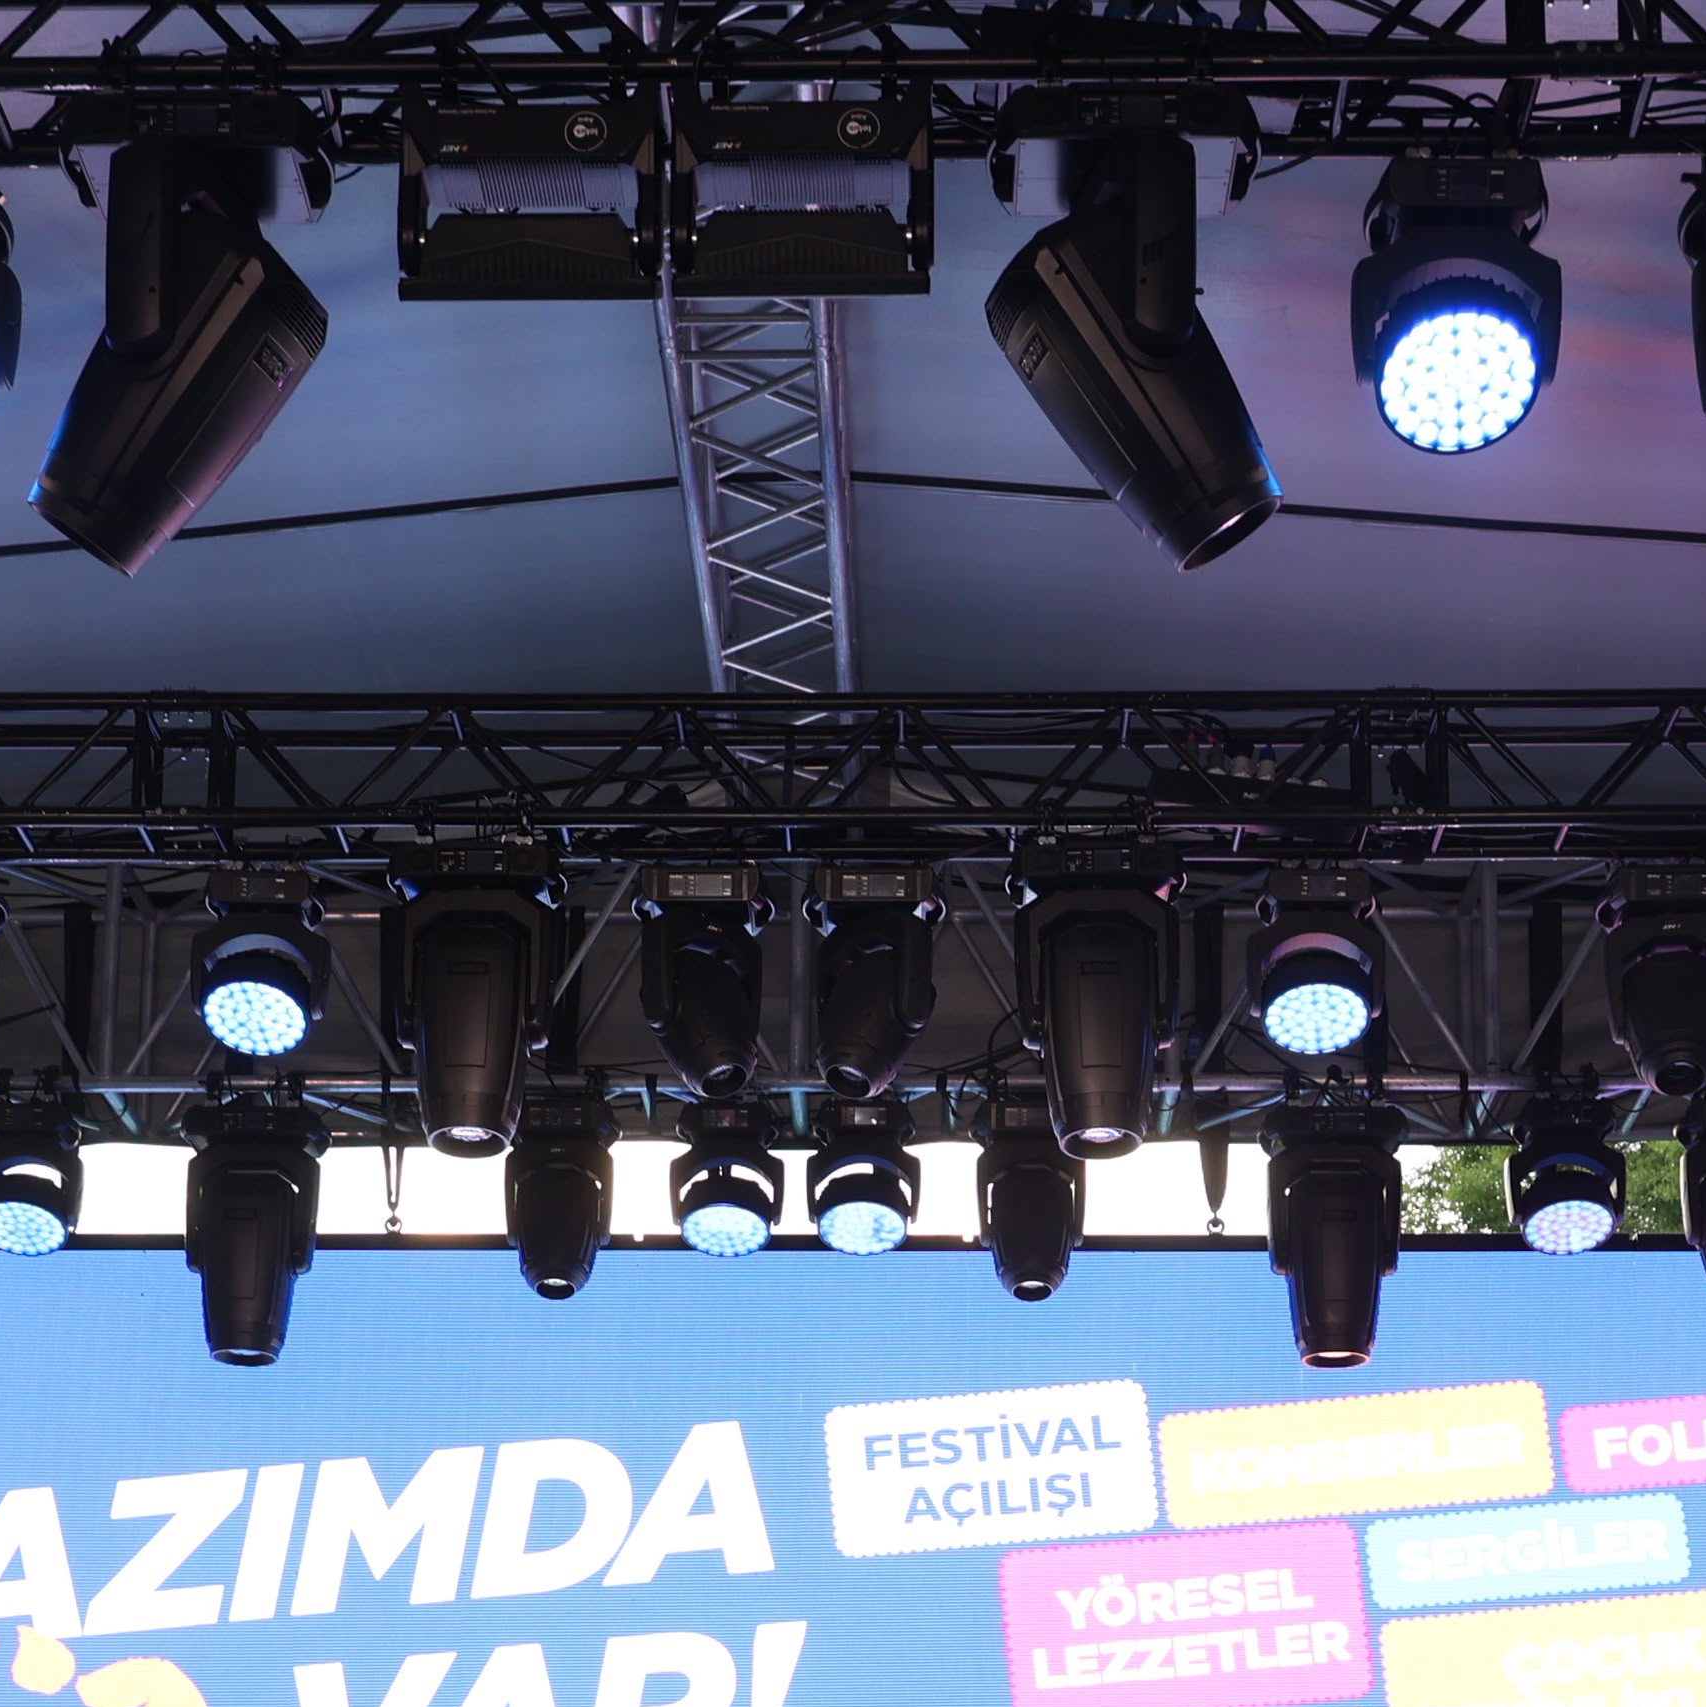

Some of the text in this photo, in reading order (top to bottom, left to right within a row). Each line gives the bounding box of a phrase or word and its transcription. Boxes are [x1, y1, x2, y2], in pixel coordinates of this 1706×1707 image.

[863, 1413, 1122, 1472] FESTİVAL
[1190, 1420, 1529, 1496] KONSERLER
[903, 1471, 1094, 1531] AÇILIŞI
[1056, 1566, 1314, 1632] YÖRESEL
[1031, 1620, 1352, 1692] LEZZETLER
